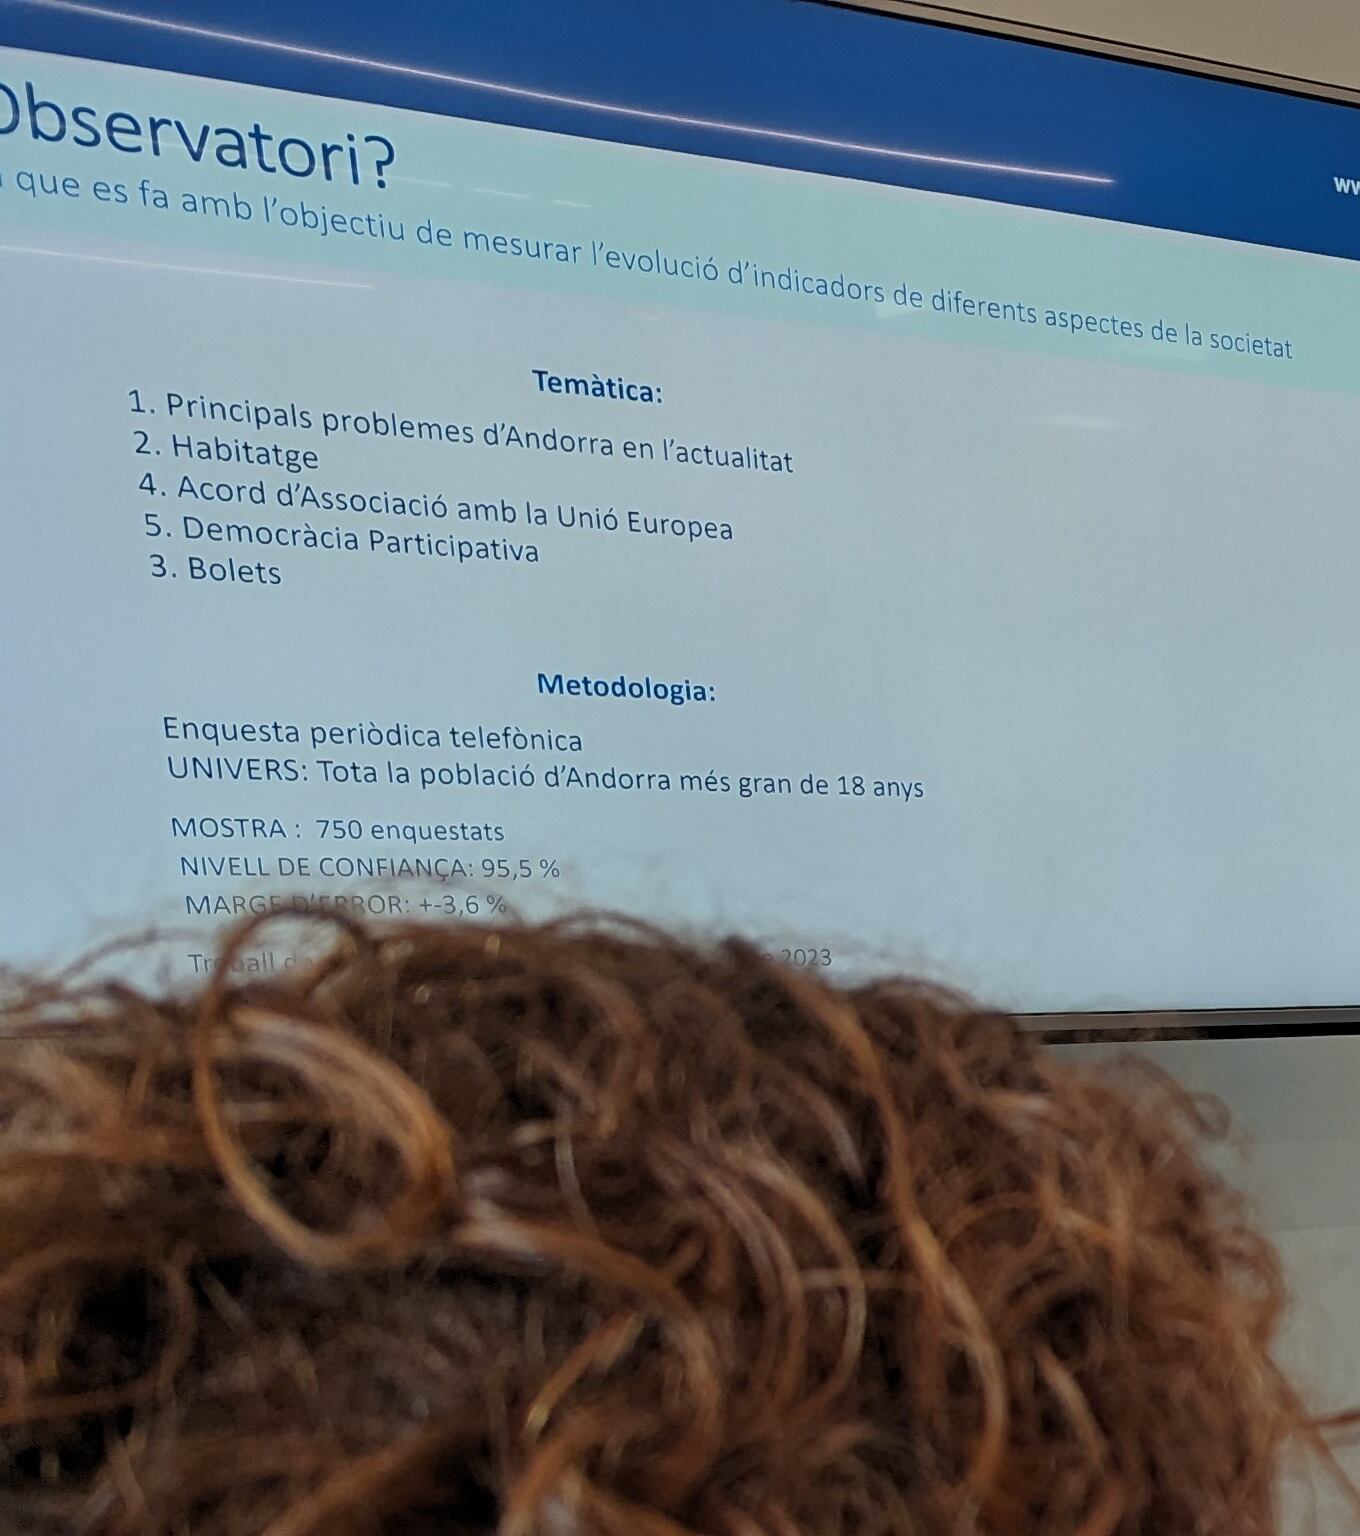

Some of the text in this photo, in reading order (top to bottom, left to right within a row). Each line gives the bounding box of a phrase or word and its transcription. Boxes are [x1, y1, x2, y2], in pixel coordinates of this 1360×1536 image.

[16, 170, 1293, 360] que es fa amb l’objectiu de mesurar l’evolució d’indicadors de diferents aspectes de la societat
[532, 369, 662, 403] Temàtica:
[128, 389, 794, 473] 1. Principals problemes d’Andorra en l’actualitat
[133, 431, 319, 473] 2. Habitatge
[139, 473, 733, 542] 4. Acord d’Associació amb la Unió Europea
[145, 513, 539, 563] 5. Democràcia Participativa
[150, 554, 281, 584] 3. Bolets
[537, 672, 716, 705] Metodologia:
[163, 716, 582, 752] Enquesta periòdica telefònica
[167, 756, 924, 802] UNIVERS: Tota la població d’Andorra més gran de 18 anys
[171, 817, 287, 839] MOSTRA
[316, 819, 363, 840] 750
[371, 822, 505, 845] enquestats
[181, 856, 561, 882] NIVELL DE CONFIANÇA: 95,5 %
[419, 895, 480, 917] +-3,6
[782, 949, 832, 966] 2023
